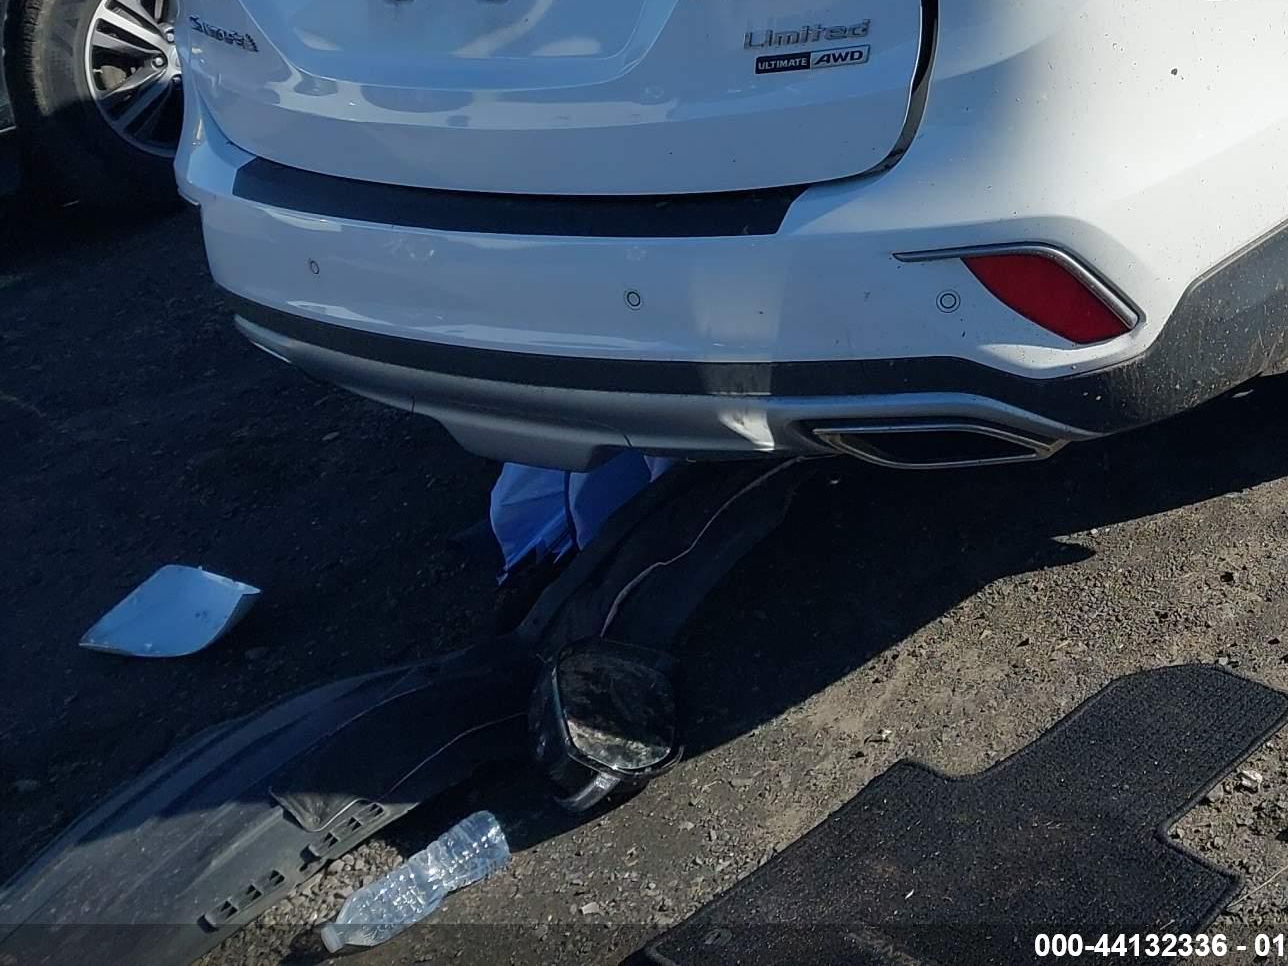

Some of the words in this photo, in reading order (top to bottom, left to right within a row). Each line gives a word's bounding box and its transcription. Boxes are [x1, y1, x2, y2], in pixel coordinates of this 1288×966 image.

[744, 19, 871, 50] Limited
[758, 58, 807, 70] ULTIMATE
[814, 50, 863, 65] AWD
